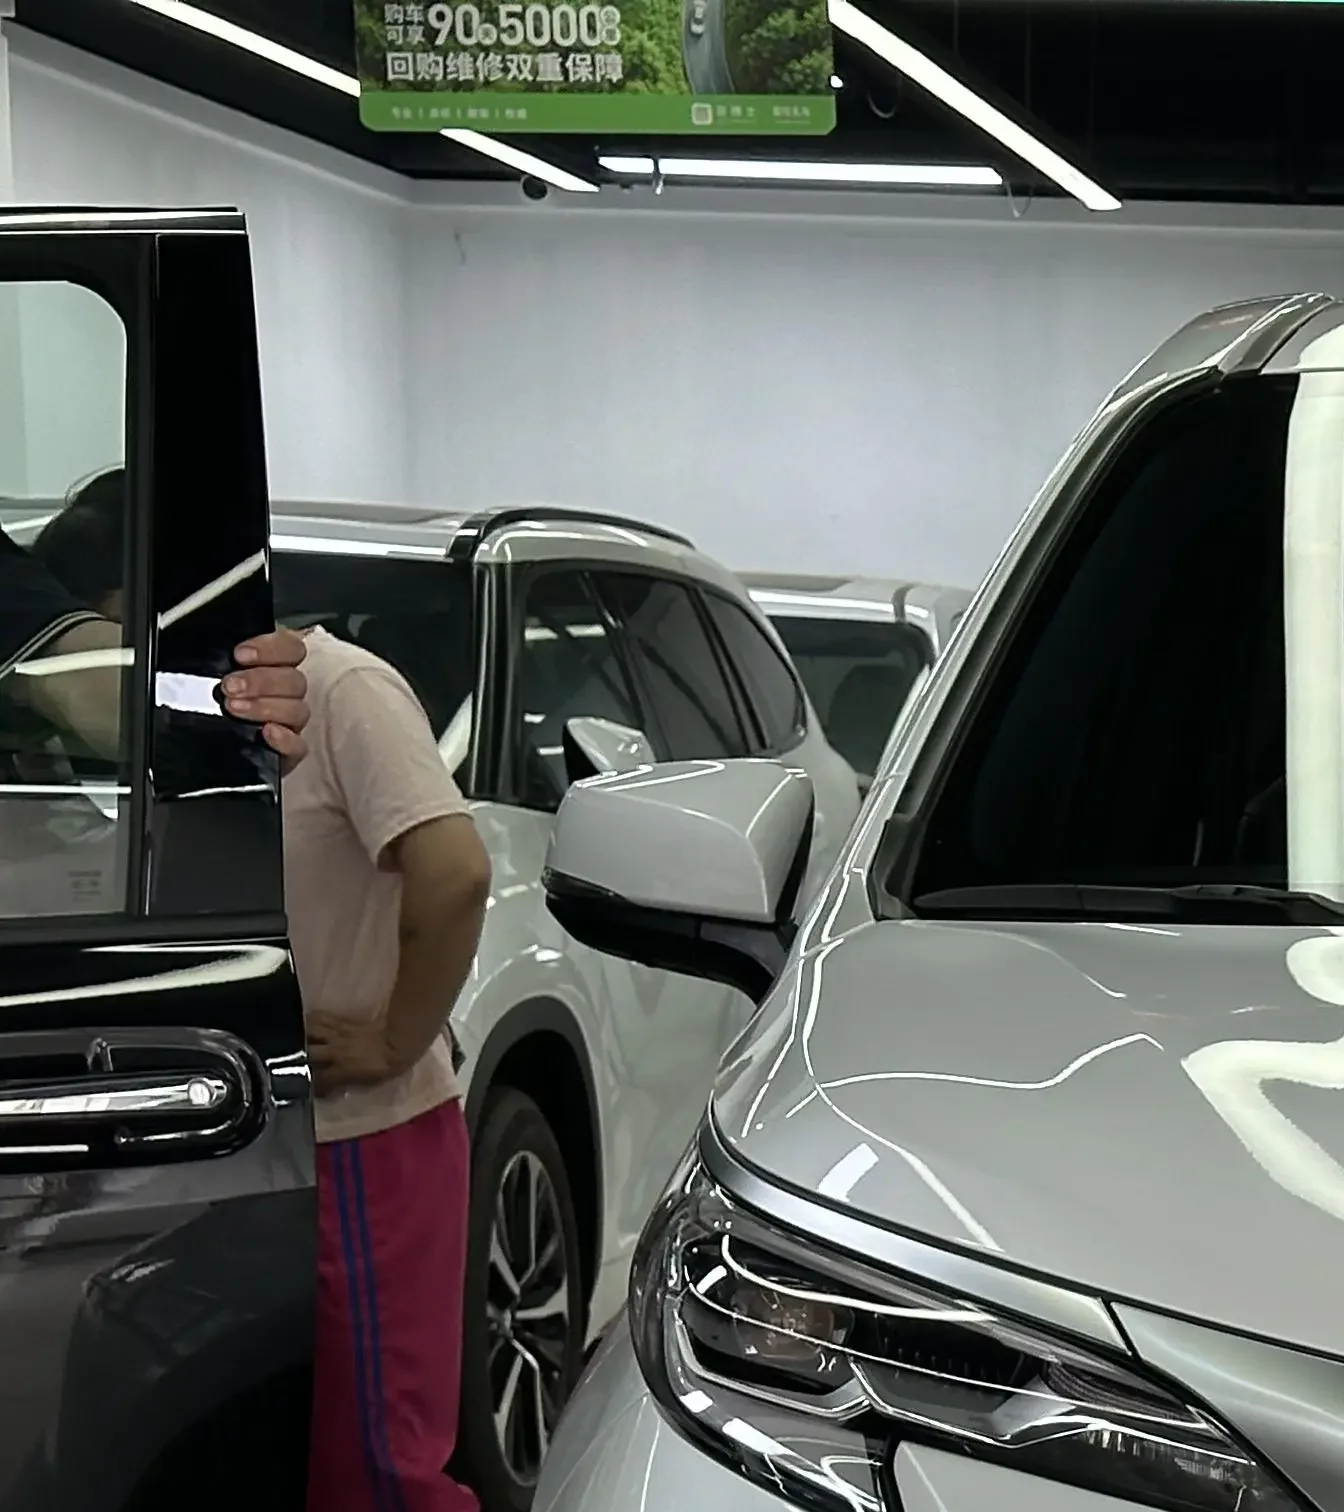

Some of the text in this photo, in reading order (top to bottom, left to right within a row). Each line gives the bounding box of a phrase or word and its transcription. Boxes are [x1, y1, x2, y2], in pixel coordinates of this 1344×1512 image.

[386, 52, 623, 83] 回购维修双重保障
